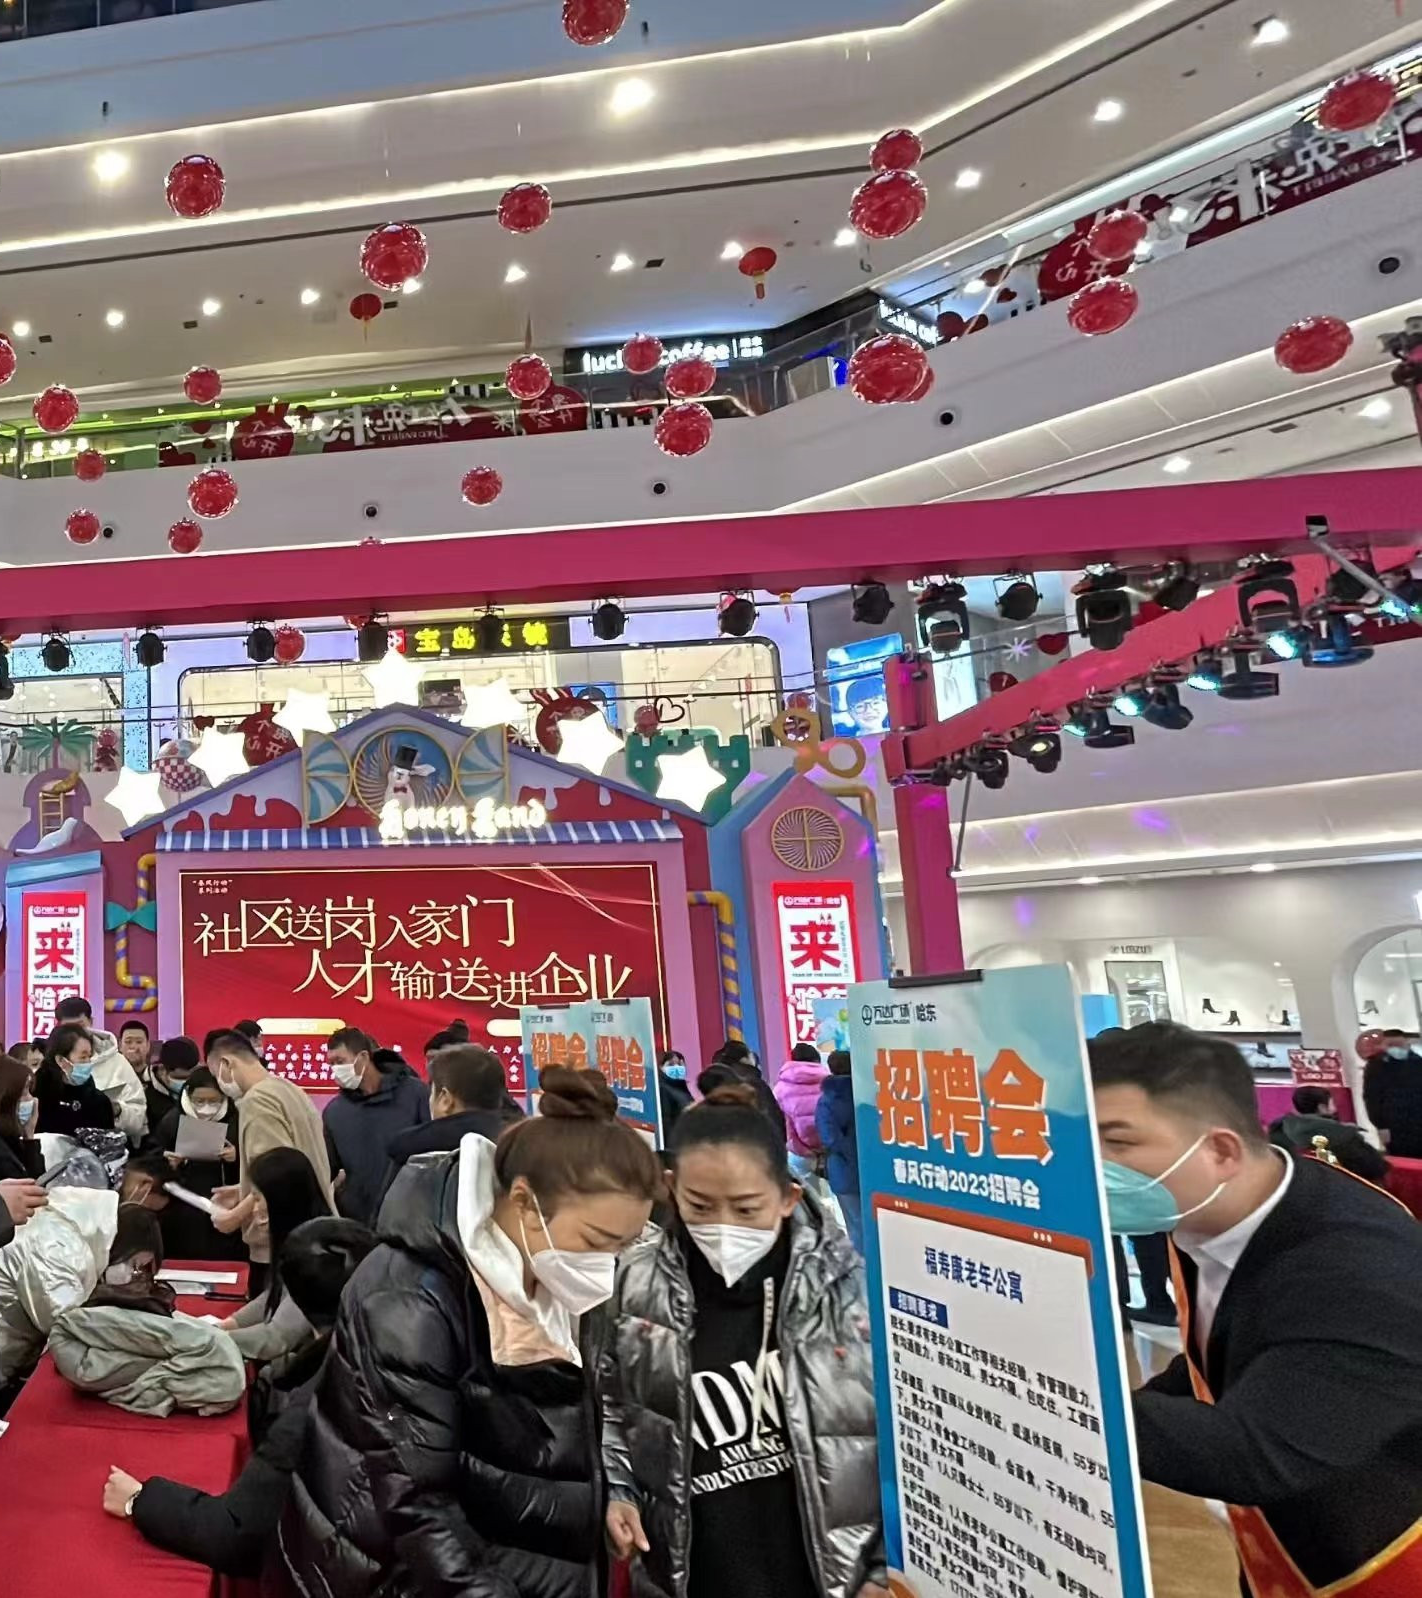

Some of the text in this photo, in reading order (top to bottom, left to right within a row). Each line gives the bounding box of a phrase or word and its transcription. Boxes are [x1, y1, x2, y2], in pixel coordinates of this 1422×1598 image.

[34, 928, 74, 973] 来
[193, 894, 515, 957] 社区送岗入家门
[790, 920, 842, 970] 来
[292, 949, 632, 1009] 人才输送进企业
[874, 1048, 1053, 1166] 招聘会
[893, 1158, 1041, 1210] 春风行动2023招聘会
[925, 1246, 1024, 1304] 福寿康老年公寓
